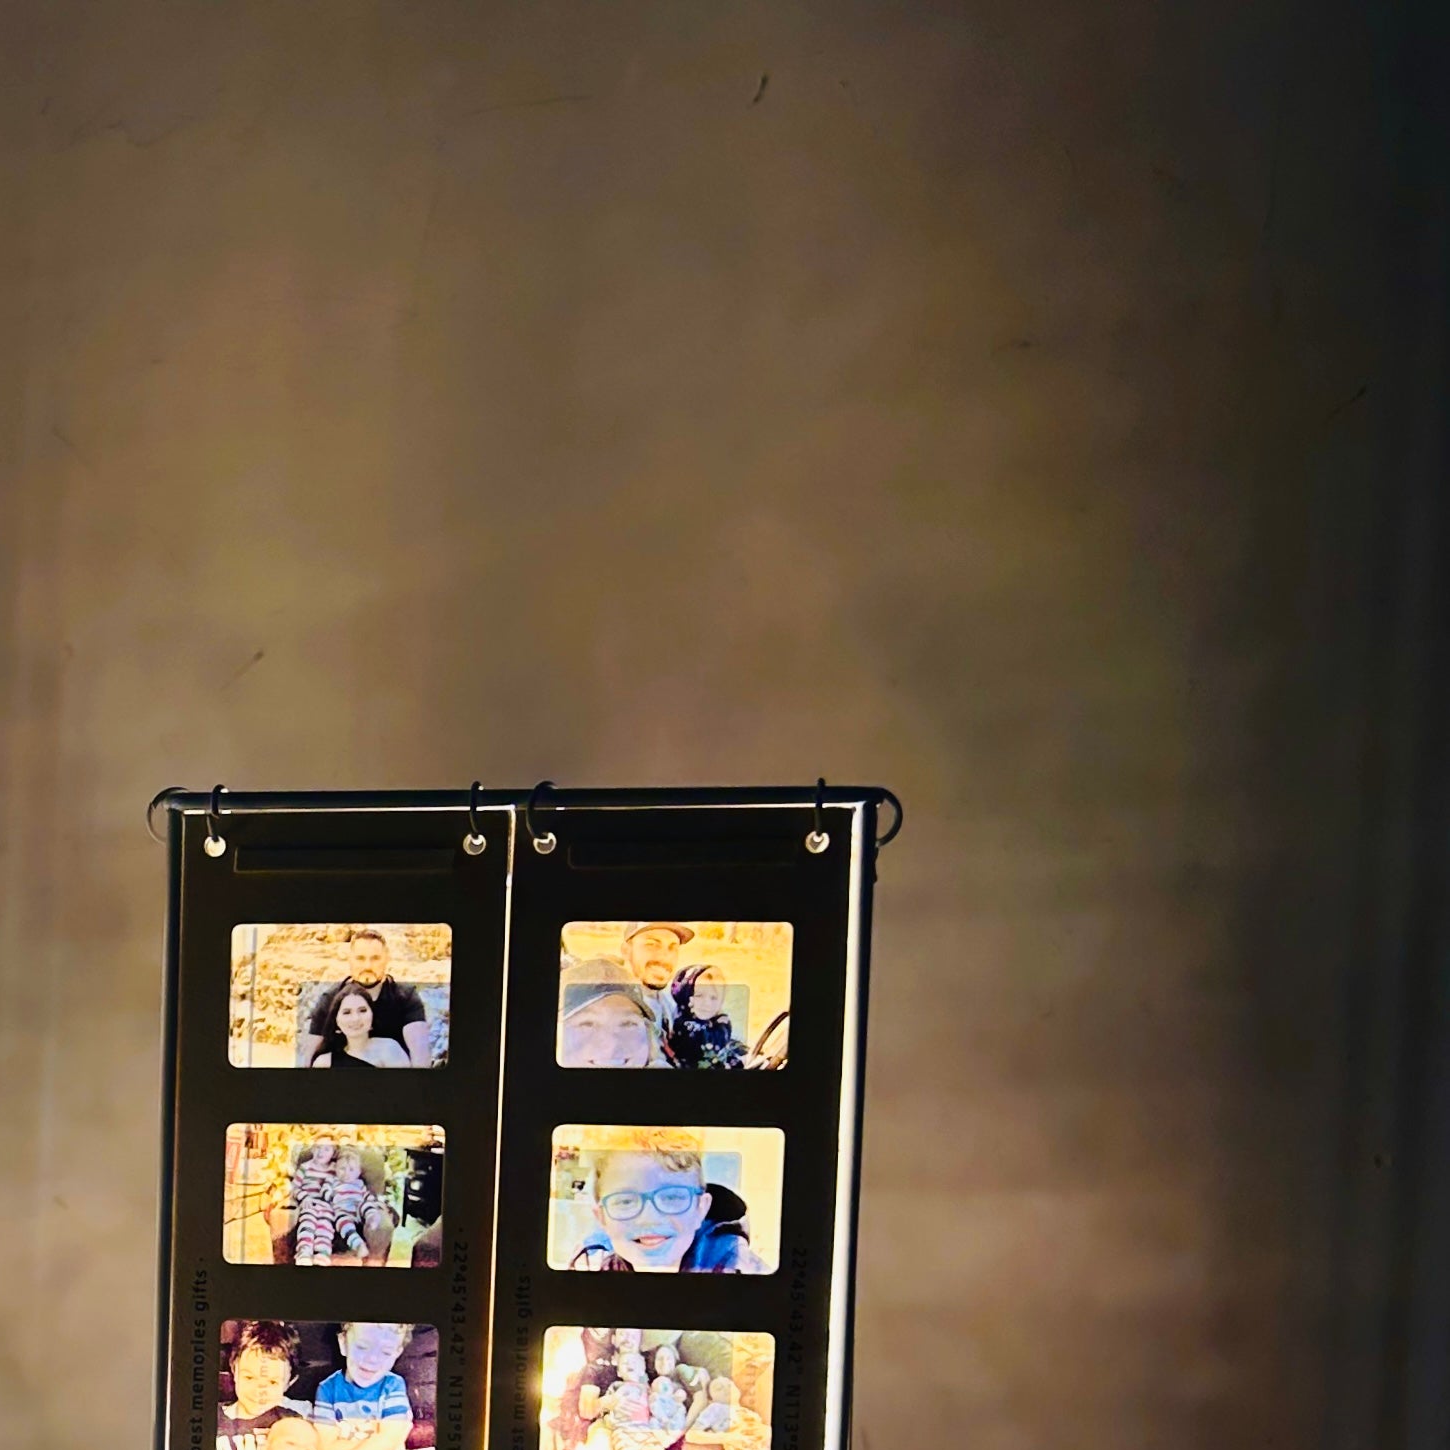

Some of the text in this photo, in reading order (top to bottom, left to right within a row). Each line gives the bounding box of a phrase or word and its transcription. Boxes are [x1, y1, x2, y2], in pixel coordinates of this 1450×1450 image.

[190, 1270, 210, 1312] gifts
[512, 1275, 533, 1318] gifts
[188, 1319, 206, 1411] memories
[510, 1326, 529, 1420] memories
